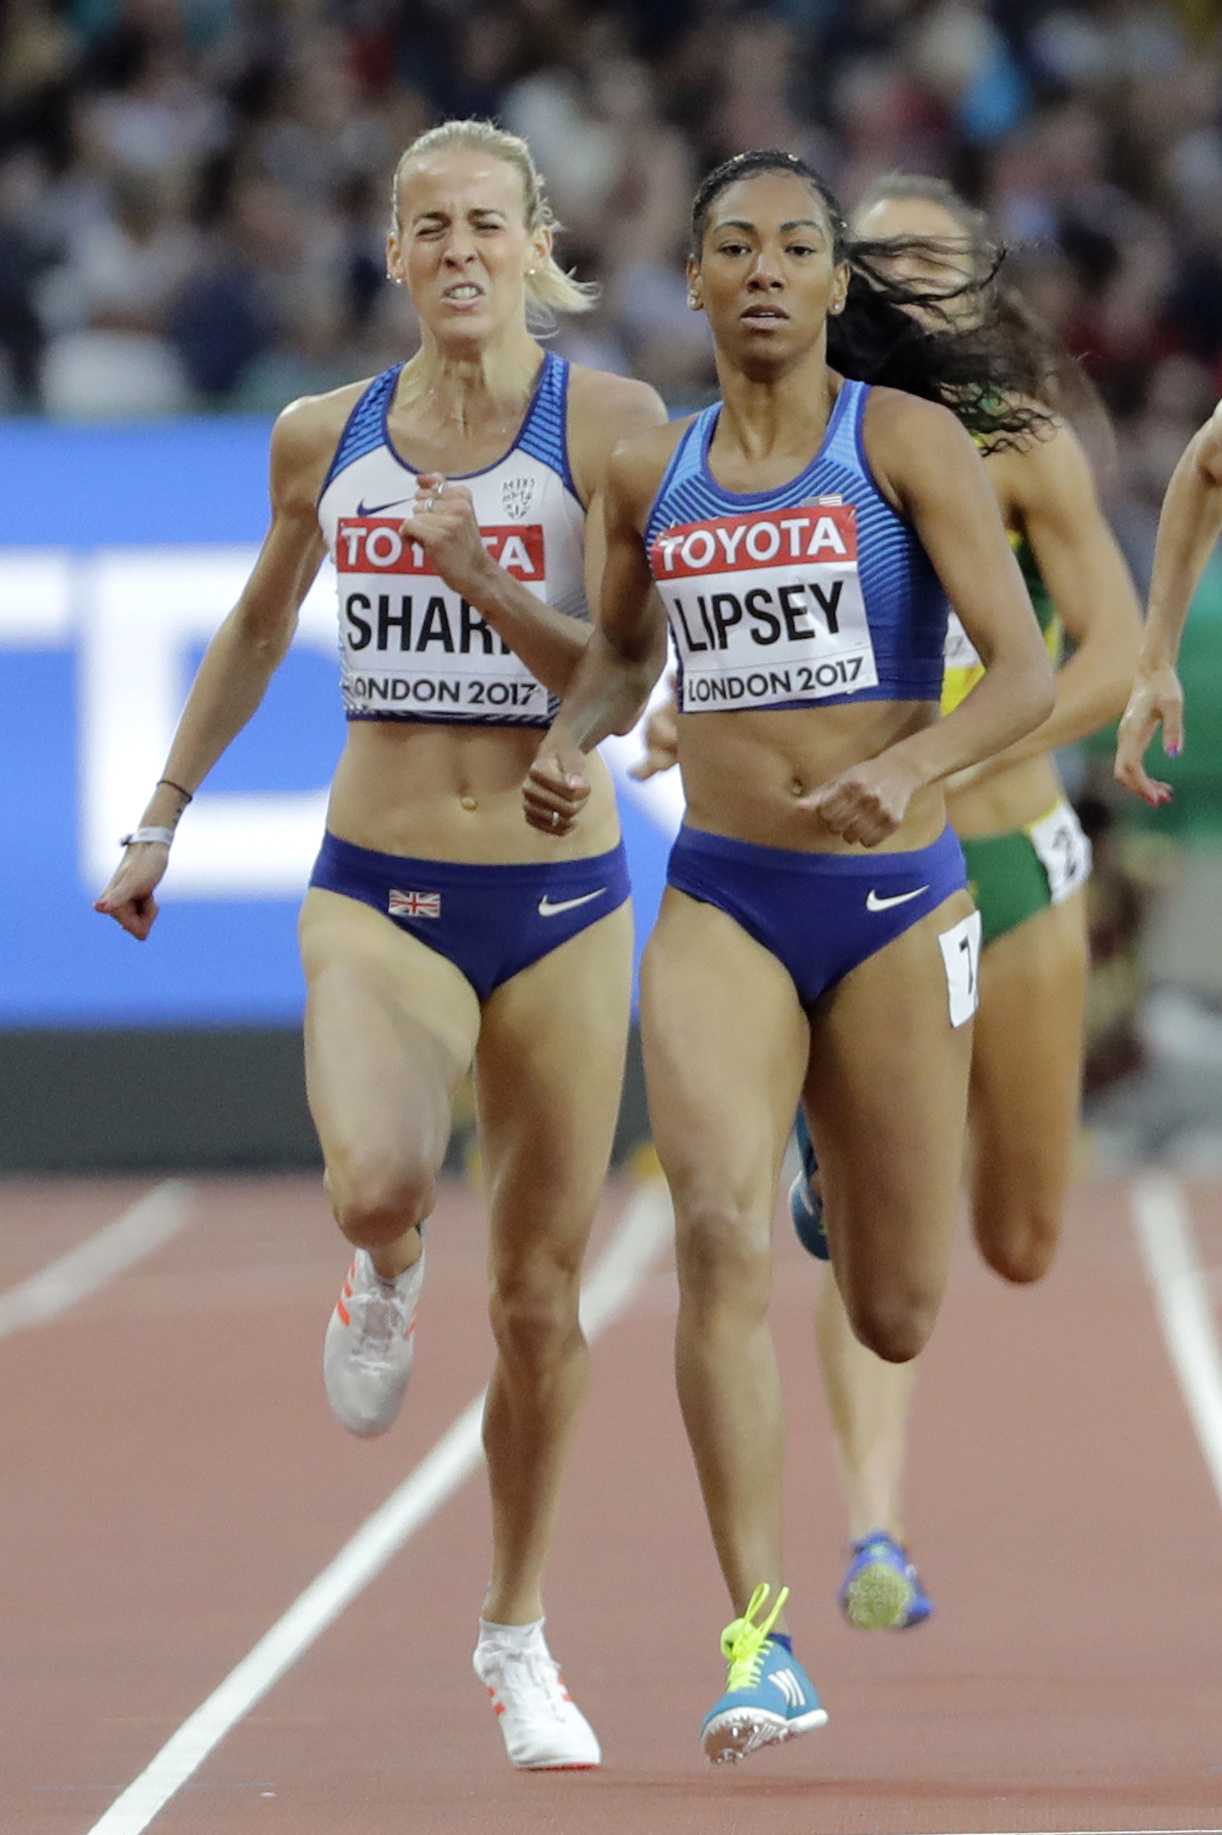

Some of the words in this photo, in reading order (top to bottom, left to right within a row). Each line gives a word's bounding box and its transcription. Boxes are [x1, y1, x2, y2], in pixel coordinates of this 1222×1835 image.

[658, 516, 847, 572] TOYOTA
[345, 592, 513, 655] SHAR
[673, 579, 844, 652] LIPSEY
[354, 676, 461, 702] ONDON
[467, 680, 537, 706] 2017
[688, 670, 792, 702] LONDON
[797, 656, 864, 690] 2017
